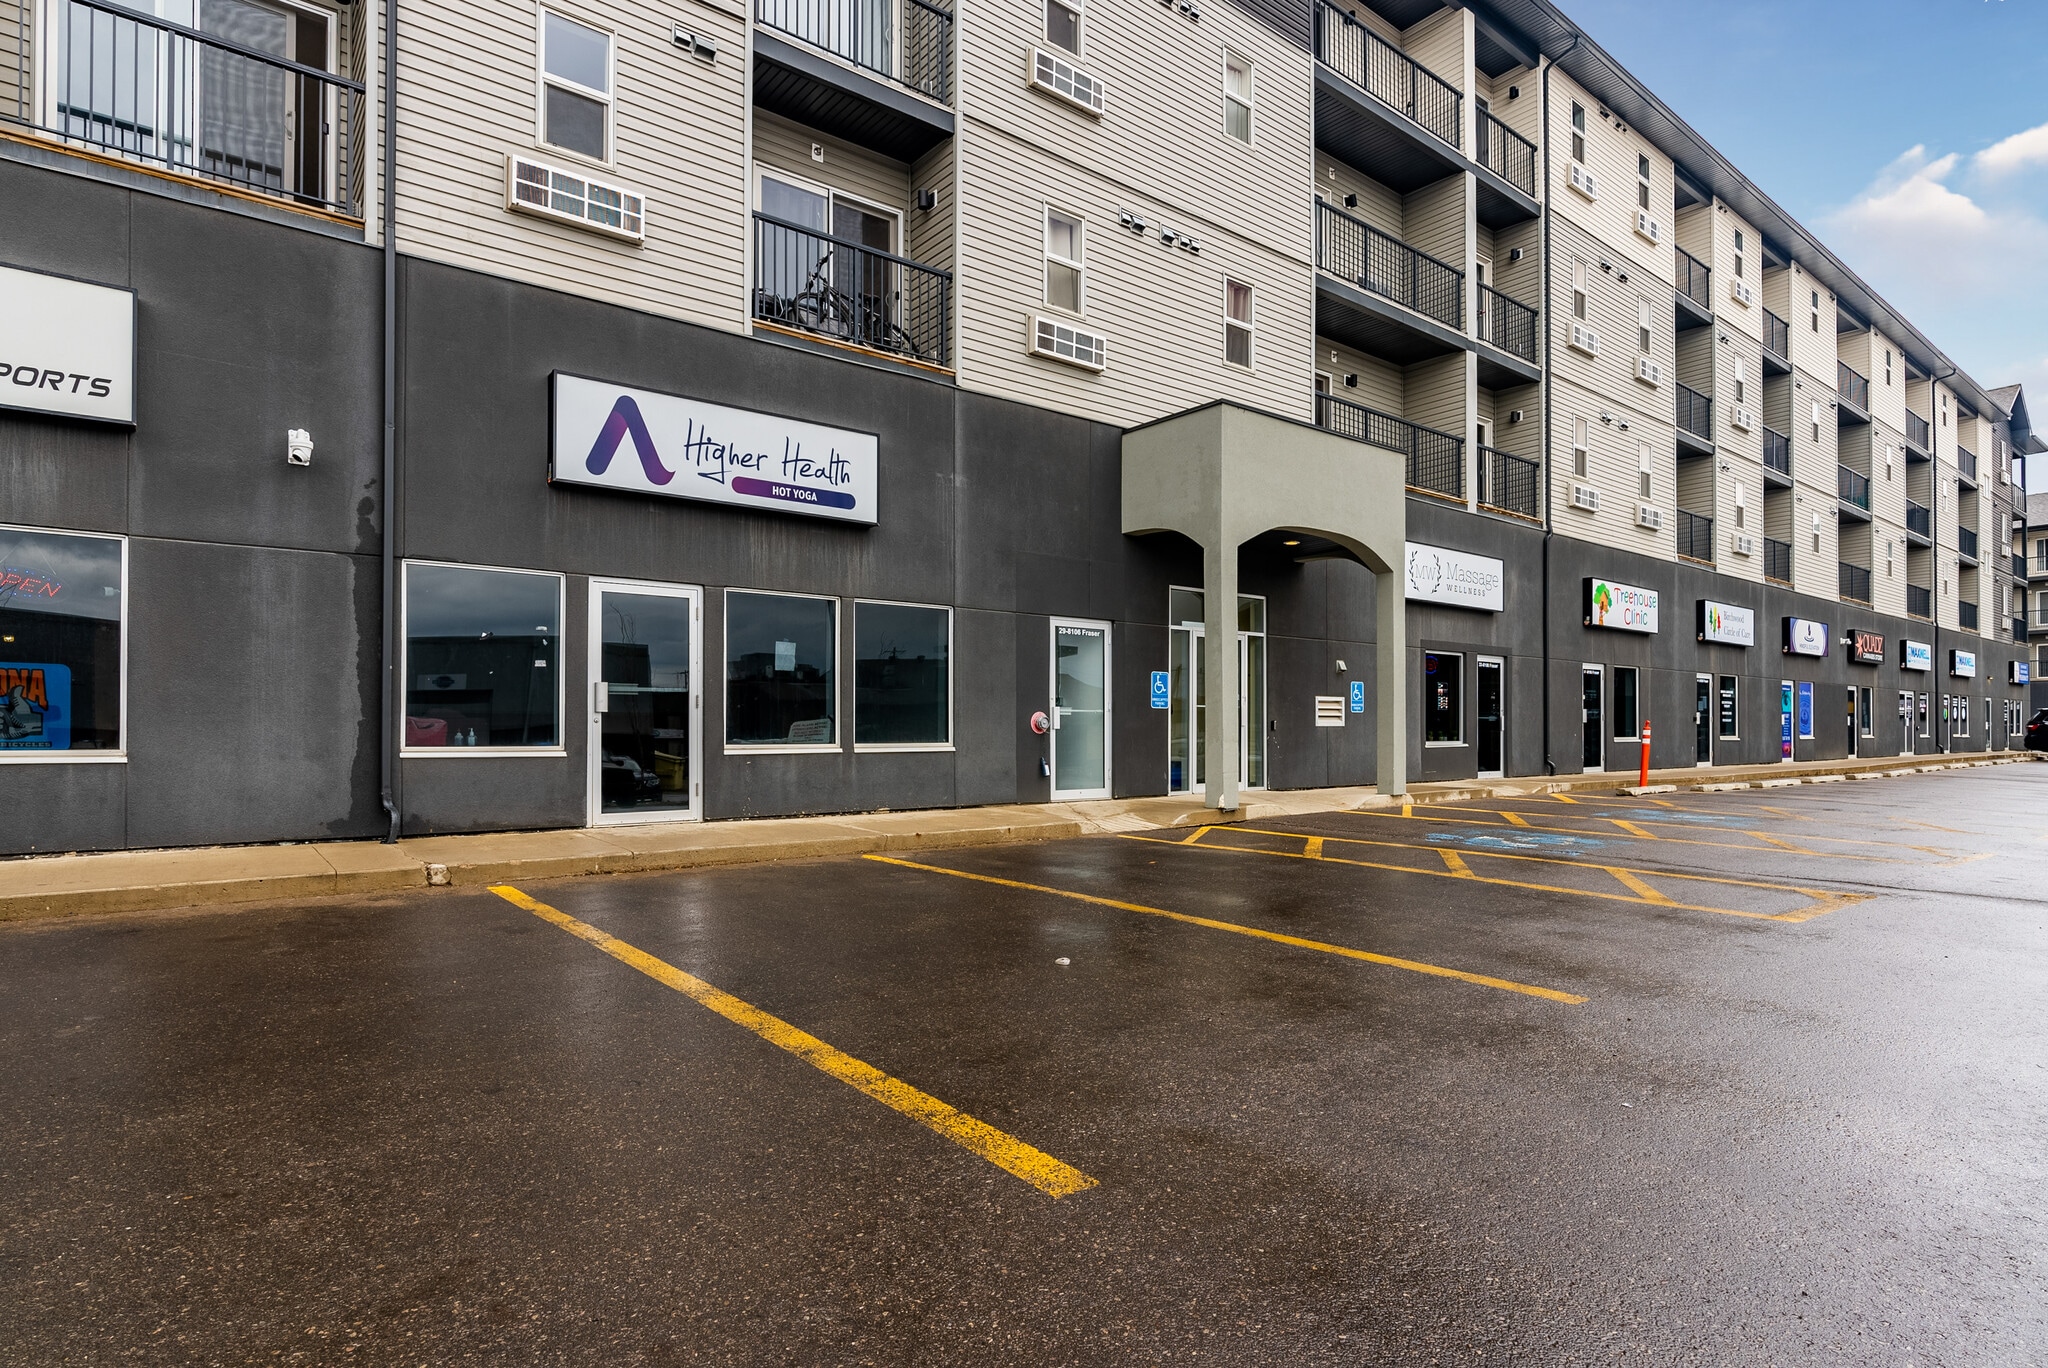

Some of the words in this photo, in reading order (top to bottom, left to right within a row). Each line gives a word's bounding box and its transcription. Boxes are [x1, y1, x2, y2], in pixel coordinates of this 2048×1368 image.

[684, 418, 768, 485] Higher
[781, 436, 851, 486] Health
[772, 485, 791, 498] HOT
[793, 488, 818, 502] YOGA
[0, 572, 62, 598] PEN
[1446, 561, 1499, 591] Massage
[1446, 583, 1486, 597] WELLNESS
[1613, 587, 1657, 608] Treehouse
[1623, 608, 1648, 625] Clinic
[1082, 629, 1101, 637] Fraser
